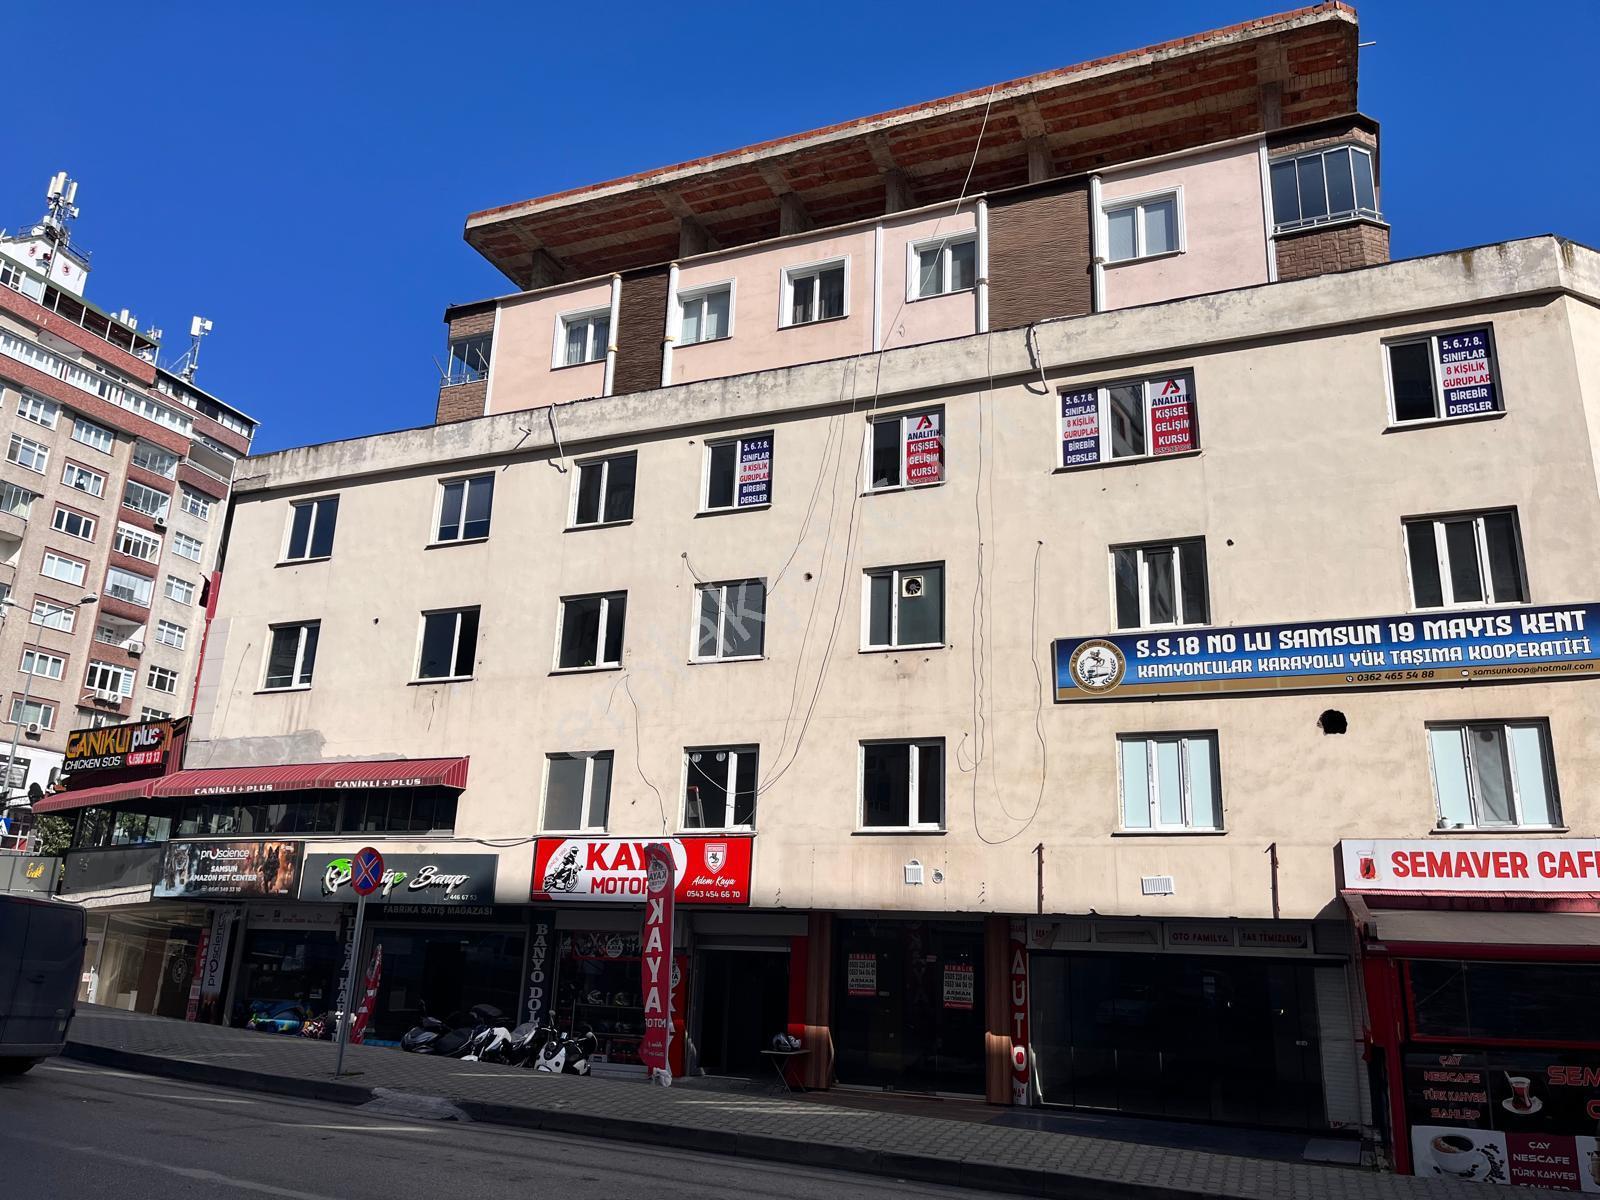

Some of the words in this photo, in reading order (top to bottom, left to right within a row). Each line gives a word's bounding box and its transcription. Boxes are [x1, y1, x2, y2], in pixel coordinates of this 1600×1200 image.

[1442, 340, 1451, 350] 5.
[1453, 339, 1462, 349] 6.
[1463, 337, 1471, 347] 7.
[1473, 336, 1482, 345] 8.
[1442, 349, 1485, 363] SINIFLAR
[1446, 367, 1452, 375] 8
[1454, 362, 1485, 374] KİŞİLİK
[1443, 374, 1491, 388] GURUPLAR
[1450, 386, 1488, 401] BİREBİR
[1065, 405, 1096, 416] SINIFLAR
[1449, 401, 1492, 415] DERSLER
[1064, 428, 1099, 439] GURUPLAR
[1158, 433, 1189, 446] KURSU
[1068, 438, 1095, 452] BİREBİR
[742, 452, 769, 462] SINIFLAR
[1067, 452, 1097, 464] DERSLER
[911, 466, 937, 477] KURSU
[740, 494, 767, 504] DERSLER
[1136, 636, 1199, 659] S.S.18
[1207, 634, 1236, 654] NO
[1244, 631, 1271, 652] LU
[1279, 624, 1381, 650] SAMSUN
[1388, 622, 1415, 643] 19
[1423, 615, 1513, 641] MAYIS
[1520, 610, 1586, 635] KENT
[1137, 659, 1253, 679] KAMYONCULAR
[1258, 653, 1344, 672] KARAYOLU
[1350, 649, 1385, 667] YÜK
[1390, 645, 1463, 666] TAŞIMA
[1469, 636, 1592, 660] KOOPERATİFİ
[1357, 673, 1382, 682] 0362
[1384, 672, 1404, 681] 465
[1407, 671, 1419, 680] 54
[1421, 670, 1434, 679] 88
[1473, 663, 1594, 677] samsunkoop@hotmail.com
[64, 758, 101, 771] CHICKEN
[101, 755, 121, 768] SOS
[247, 784, 273, 792] PLUS
[392, 778, 421, 787] PLUS
[210, 865, 238, 873] SAMSUN
[1391, 850, 1529, 878] SEMAVER
[189, 874, 217, 882] AMAZON
[218, 874, 231, 882] PET
[231, 874, 257, 882] CENTER
[715, 875, 736, 888] Kaya
[686, 890, 704, 898] 0543
[705, 890, 719, 898] 454
[720, 890, 730, 898] 66
[732, 890, 741, 898] 70
[532, 924, 548, 983] BANYO
[1528, 1141, 1552, 1151] ÇAY
[1513, 1153, 1571, 1165] NESCAFE
